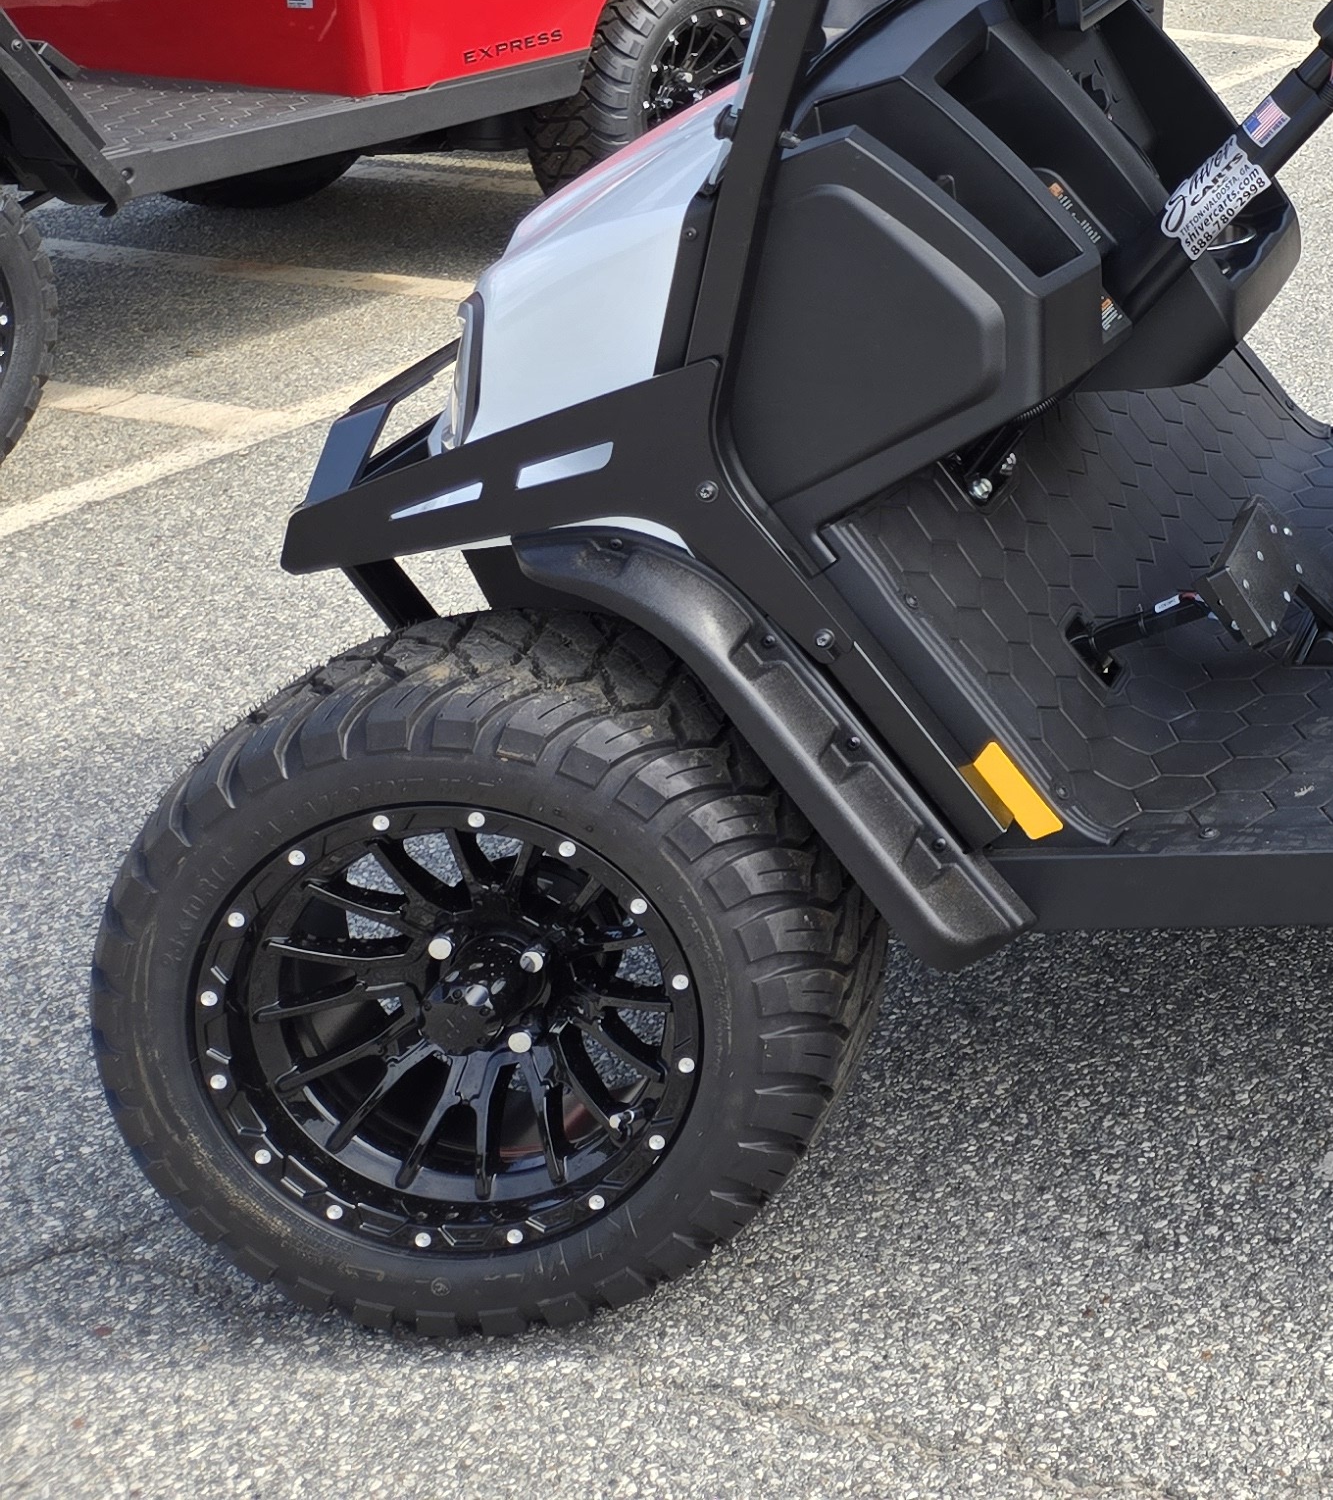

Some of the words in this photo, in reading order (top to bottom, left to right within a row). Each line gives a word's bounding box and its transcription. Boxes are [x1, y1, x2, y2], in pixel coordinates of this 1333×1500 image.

[463, 29, 563, 65] EXPRESS
[1184, 167, 1260, 248] shivercarts.com
[1190, 152, 1243, 207] CARTS
[1190, 176, 1266, 257] 888-780-2998
